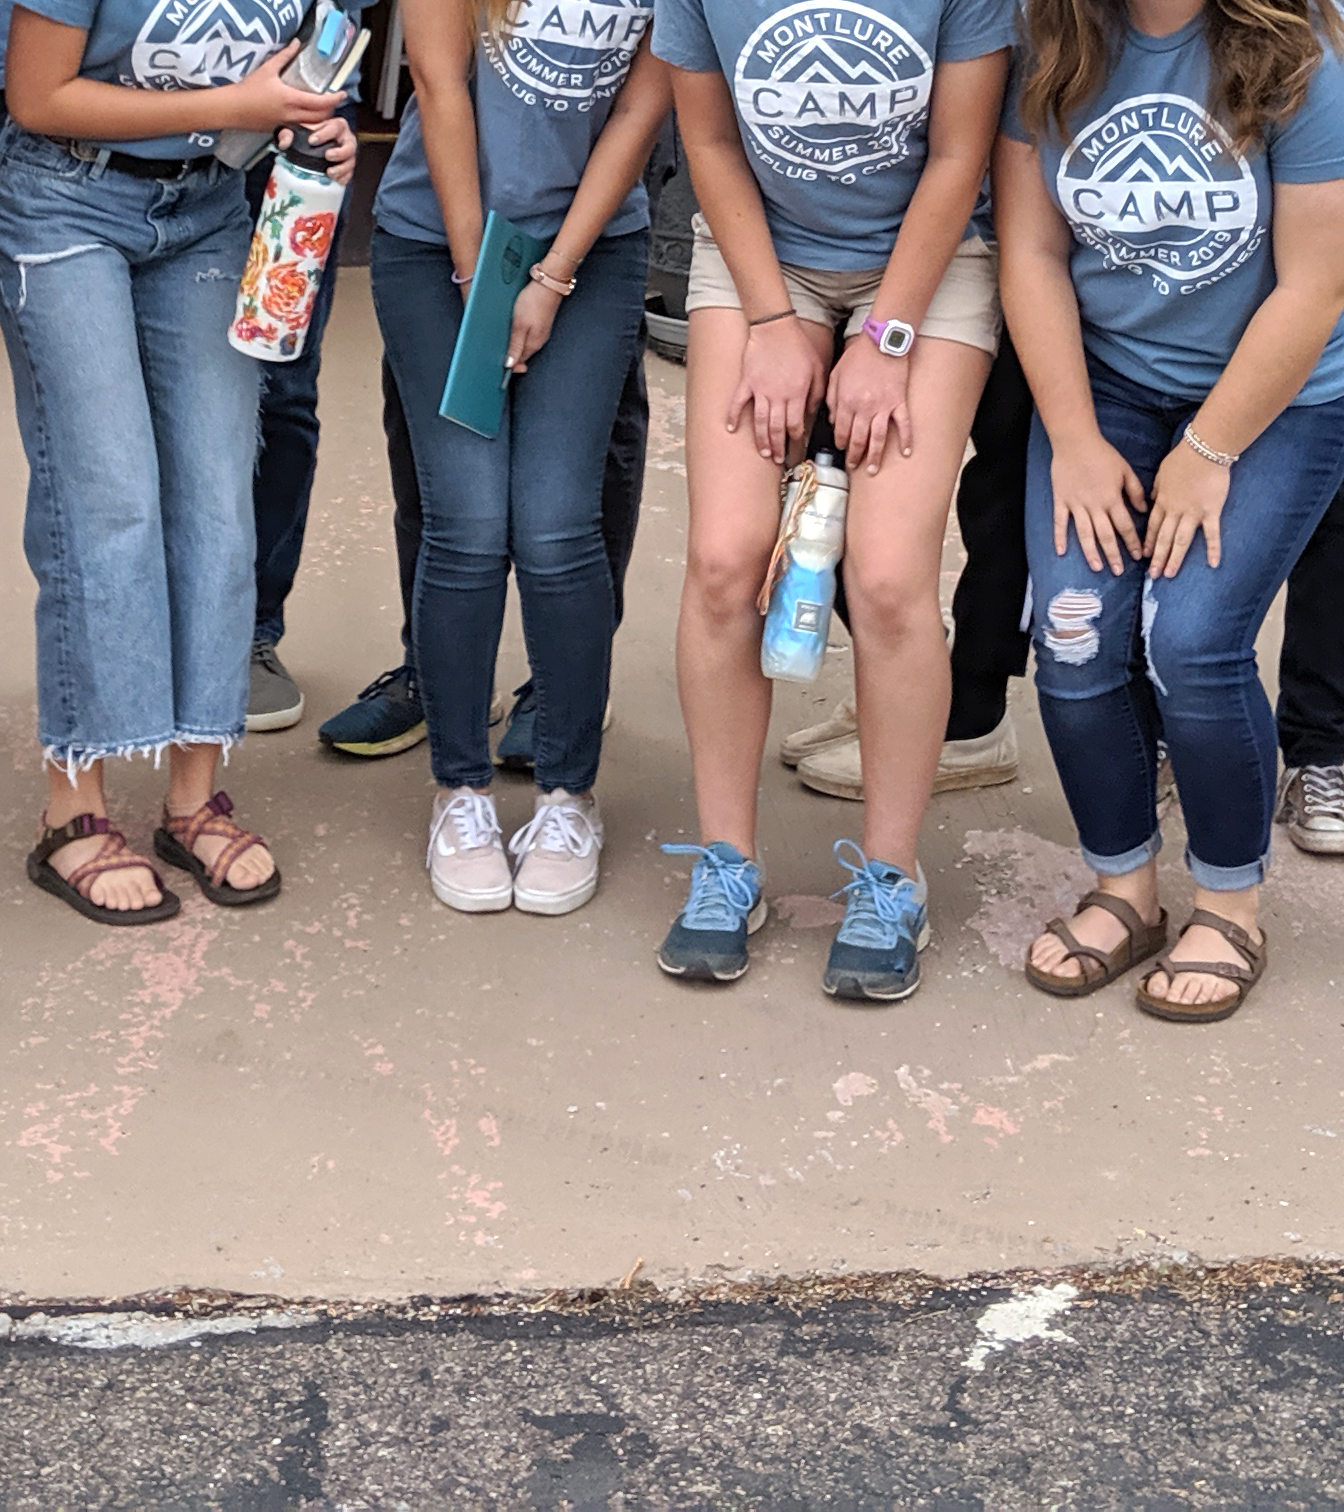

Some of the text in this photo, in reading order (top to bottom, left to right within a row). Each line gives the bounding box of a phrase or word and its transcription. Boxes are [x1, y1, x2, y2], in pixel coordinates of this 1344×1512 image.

[757, 12, 910, 65] MONTLURE
[481, 31, 537, 106] UNPLUG
[543, 98, 579, 112] TO
[508, 38, 584, 87] SUMMER
[753, 86, 919, 121] CAMP
[768, 126, 860, 163] SUMMER
[1081, 107, 1224, 163] MONTLURE
[827, 172, 857, 186] TO
[1072, 188, 1240, 225] CAMP
[1188, 231, 1233, 267] 2019
[1152, 274, 1171, 296] TO
